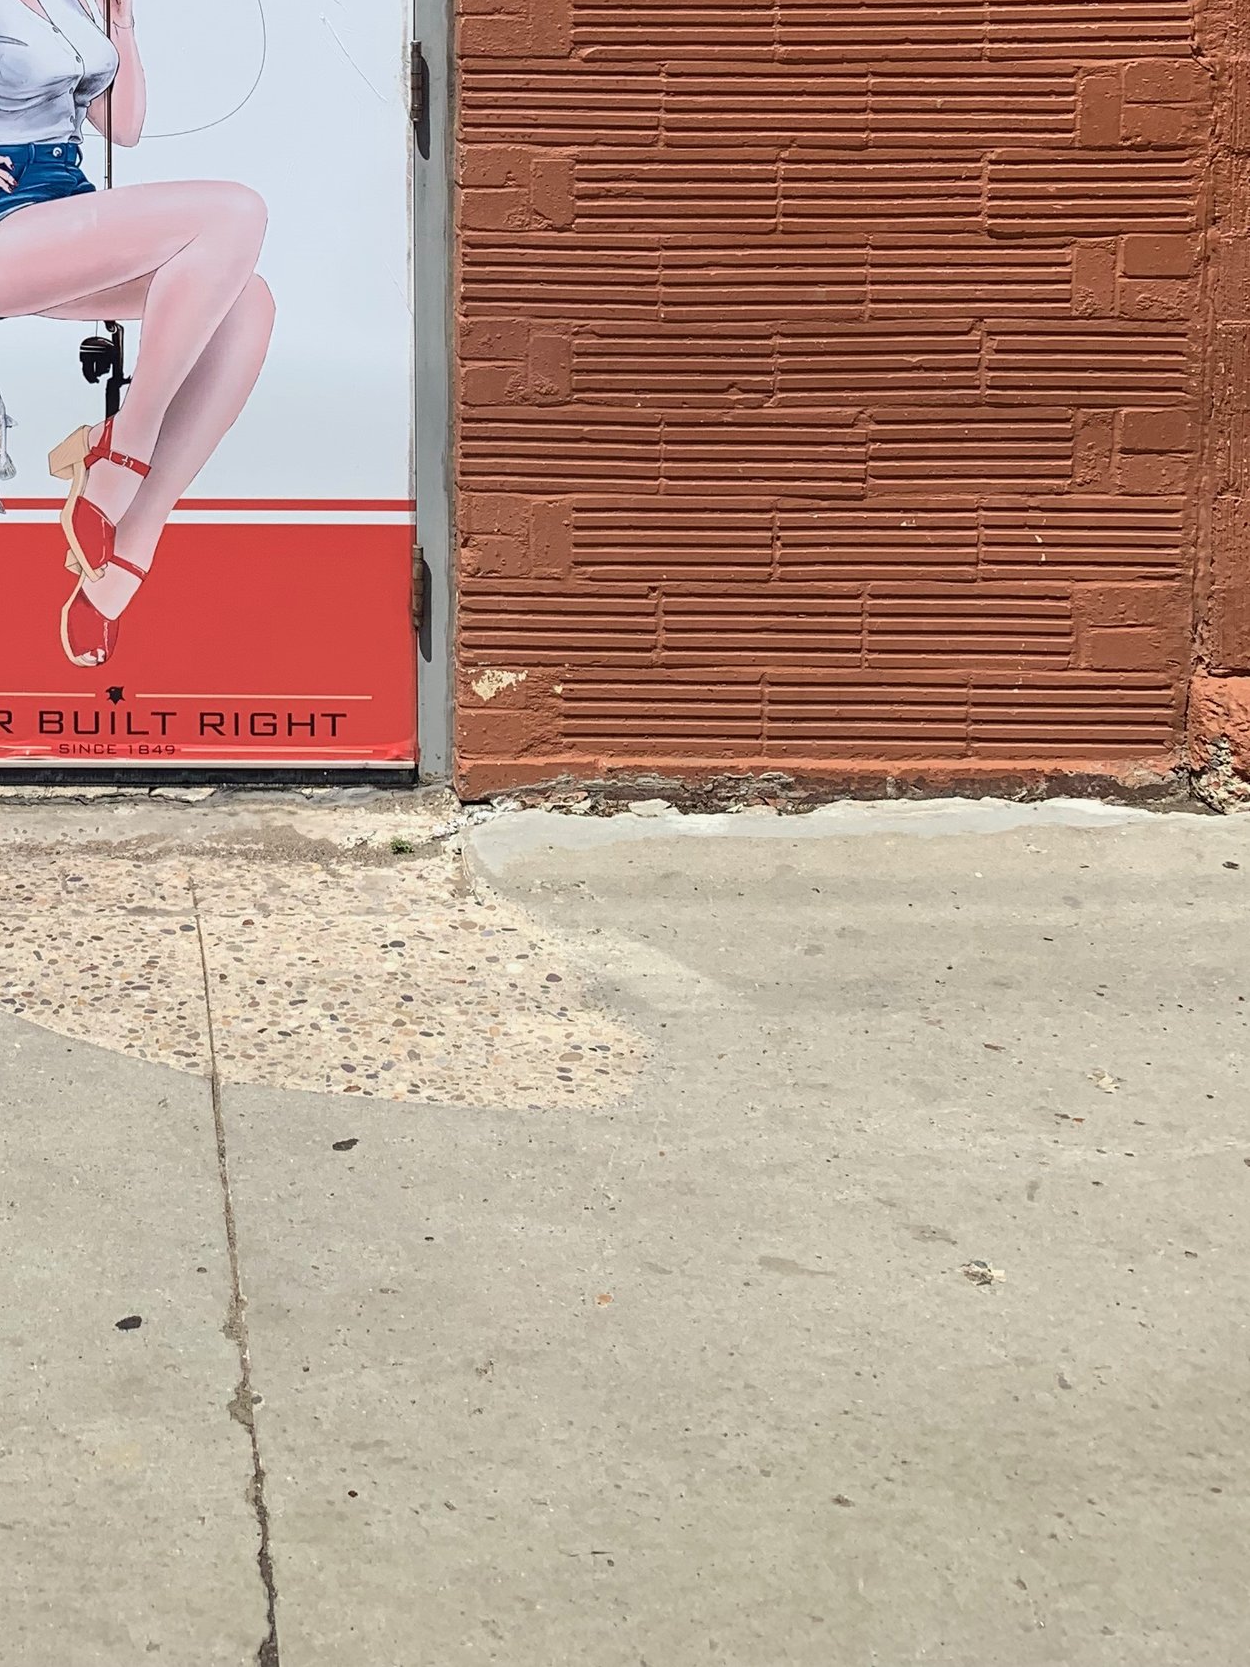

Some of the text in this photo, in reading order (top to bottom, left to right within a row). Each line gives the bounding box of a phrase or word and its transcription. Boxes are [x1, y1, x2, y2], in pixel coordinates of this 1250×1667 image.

[38, 709, 178, 736] BUILT
[198, 710, 348, 738] RIGHT
[58, 742, 176, 756] SINCE 1849
